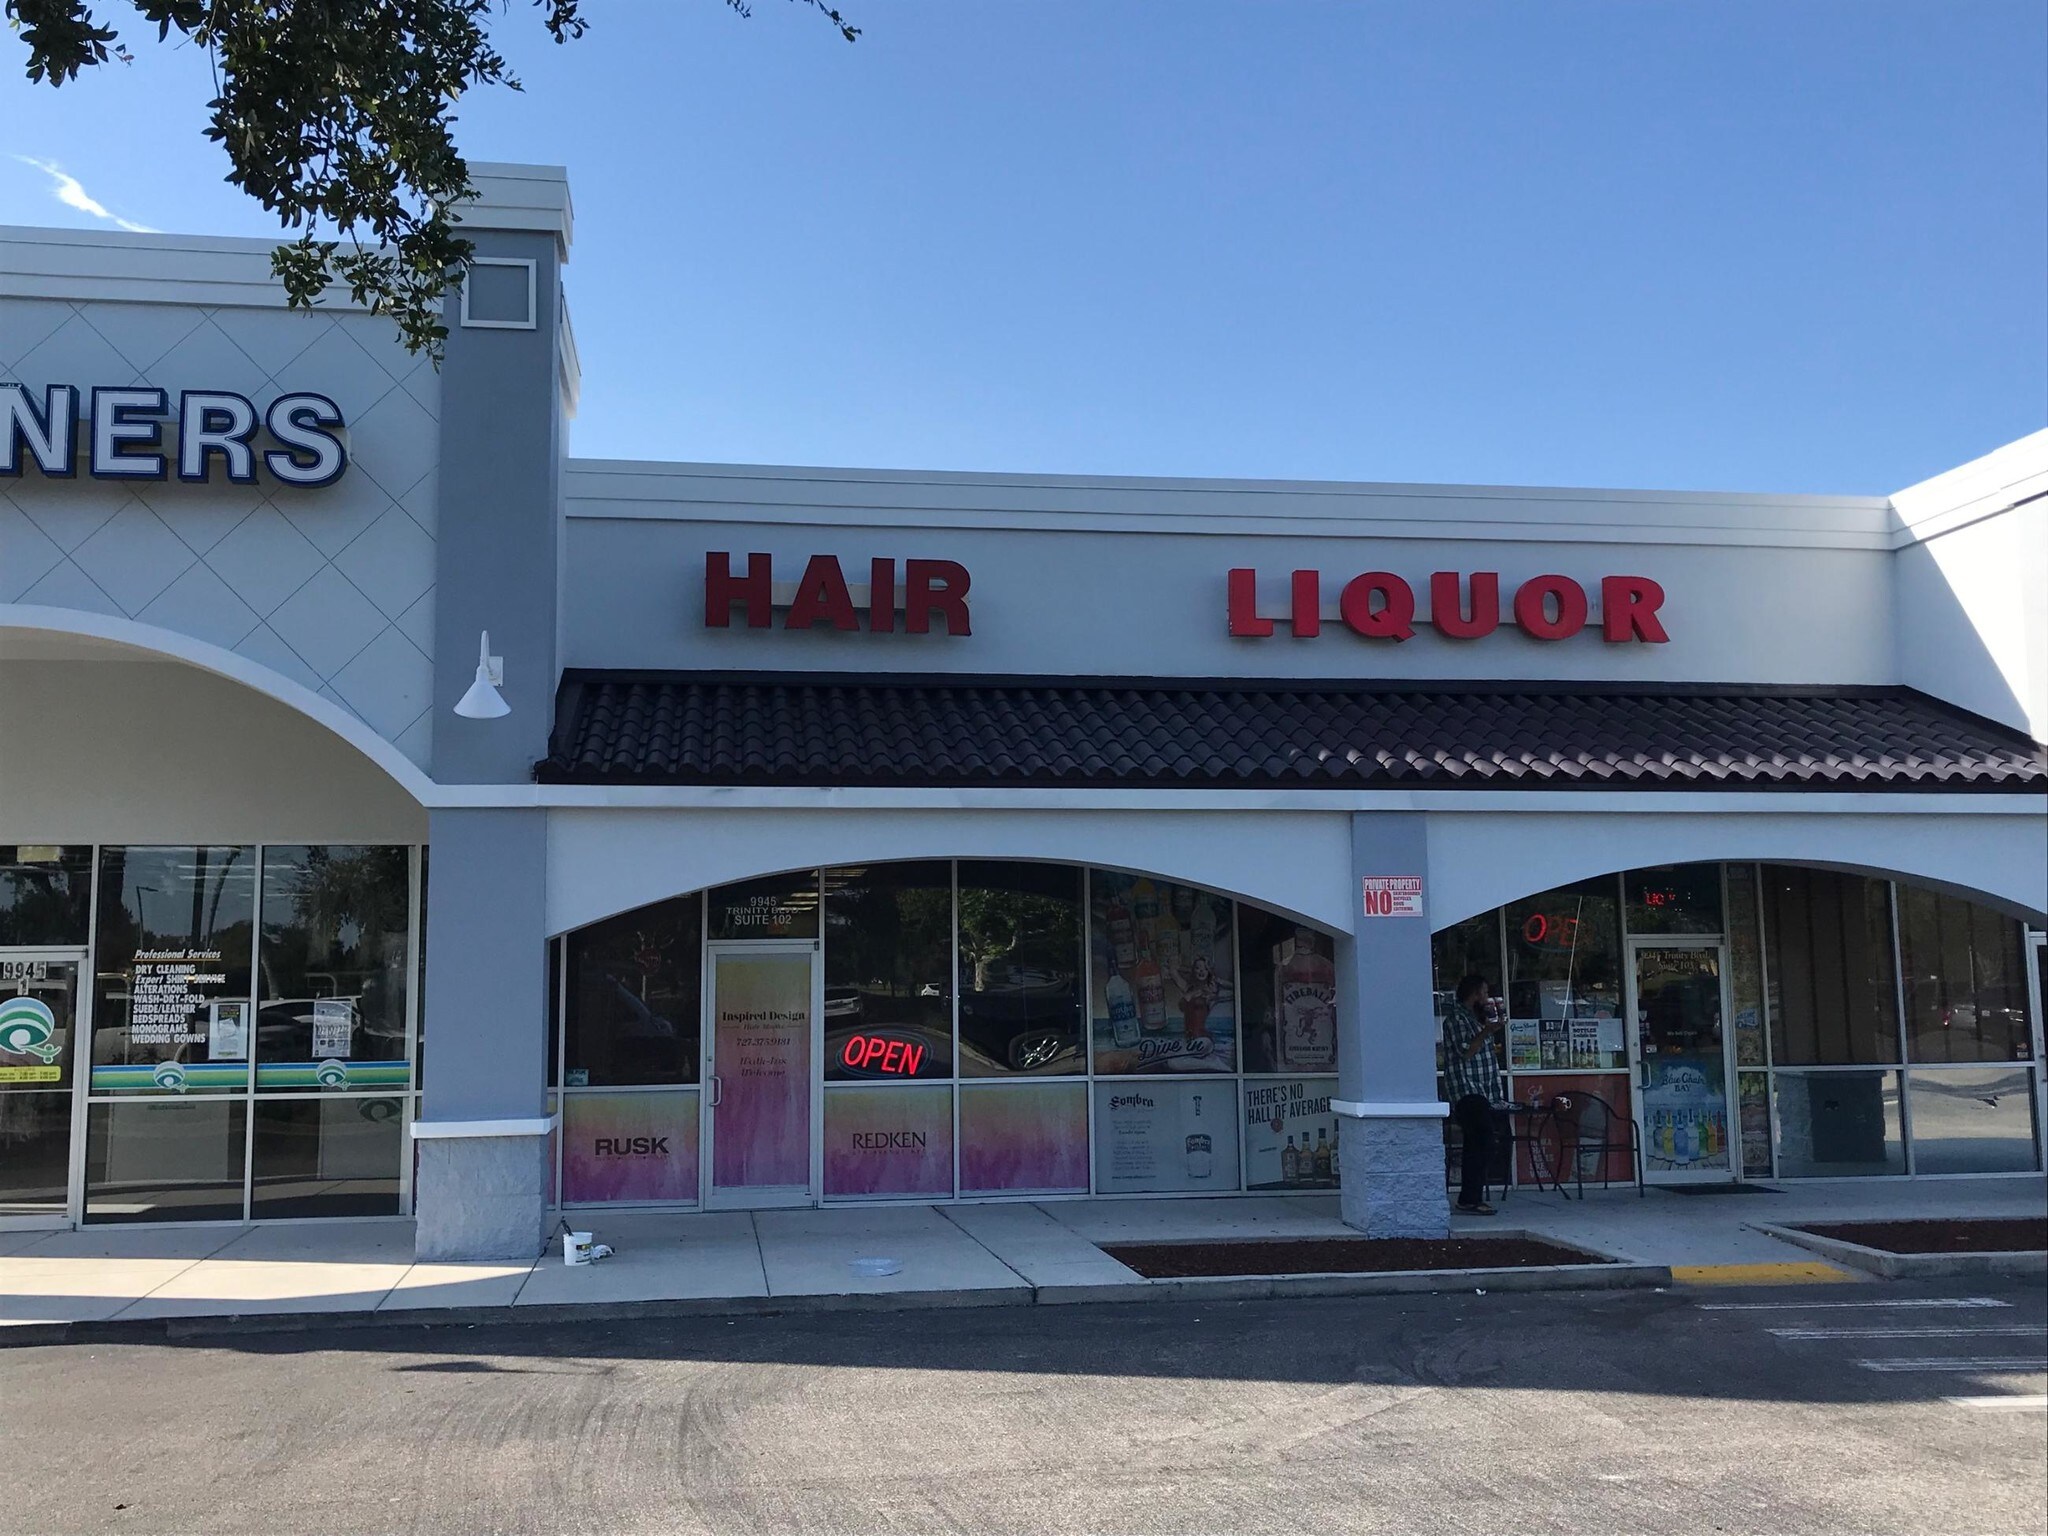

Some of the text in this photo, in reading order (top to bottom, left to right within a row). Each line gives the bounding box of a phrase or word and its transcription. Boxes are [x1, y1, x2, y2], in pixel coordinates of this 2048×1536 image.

[0, 383, 348, 488] NERS
[705, 551, 972, 636] HAIR
[1228, 568, 1670, 643] LIQUOR
[1364, 878, 1420, 890] PRIVATE PROPERTY
[750, 897, 777, 906] 9945
[1366, 891, 1392, 915] NO
[734, 914, 792, 925] SUITE 102
[134, 949, 221, 959] Professional Services
[4, 962, 46, 979] 9945
[135, 964, 196, 975] DRY CLEANING
[135, 973, 226, 985] Expert SHIRT SERVICE
[134, 984, 188, 995] ALTERATIONS
[133, 994, 205, 1004] WASH-DRY-FOLD
[1285, 987, 1330, 1005] FIREBALL
[133, 1004, 196, 1014] SUEDE/LEATHER
[132, 1014, 186, 1024] BEDSPREADS
[722, 1011, 805, 1023] Inspired Design
[131, 1024, 189, 1034] MONOGRAMS
[131, 1033, 206, 1044] WEDDING GOWNS
[844, 1035, 924, 1075] OPEN
[1139, 1039, 1182, 1061] Dive
[1675, 1084, 1691, 1092] BAY
[1247, 1083, 1303, 1107] THERE'S NO
[1108, 1092, 1154, 1111] Sombra
[1248, 1096, 1332, 1125] HALL OF AVERAGE
[595, 1137, 670, 1156] RUSK
[852, 1131, 926, 1150] REDKEN
